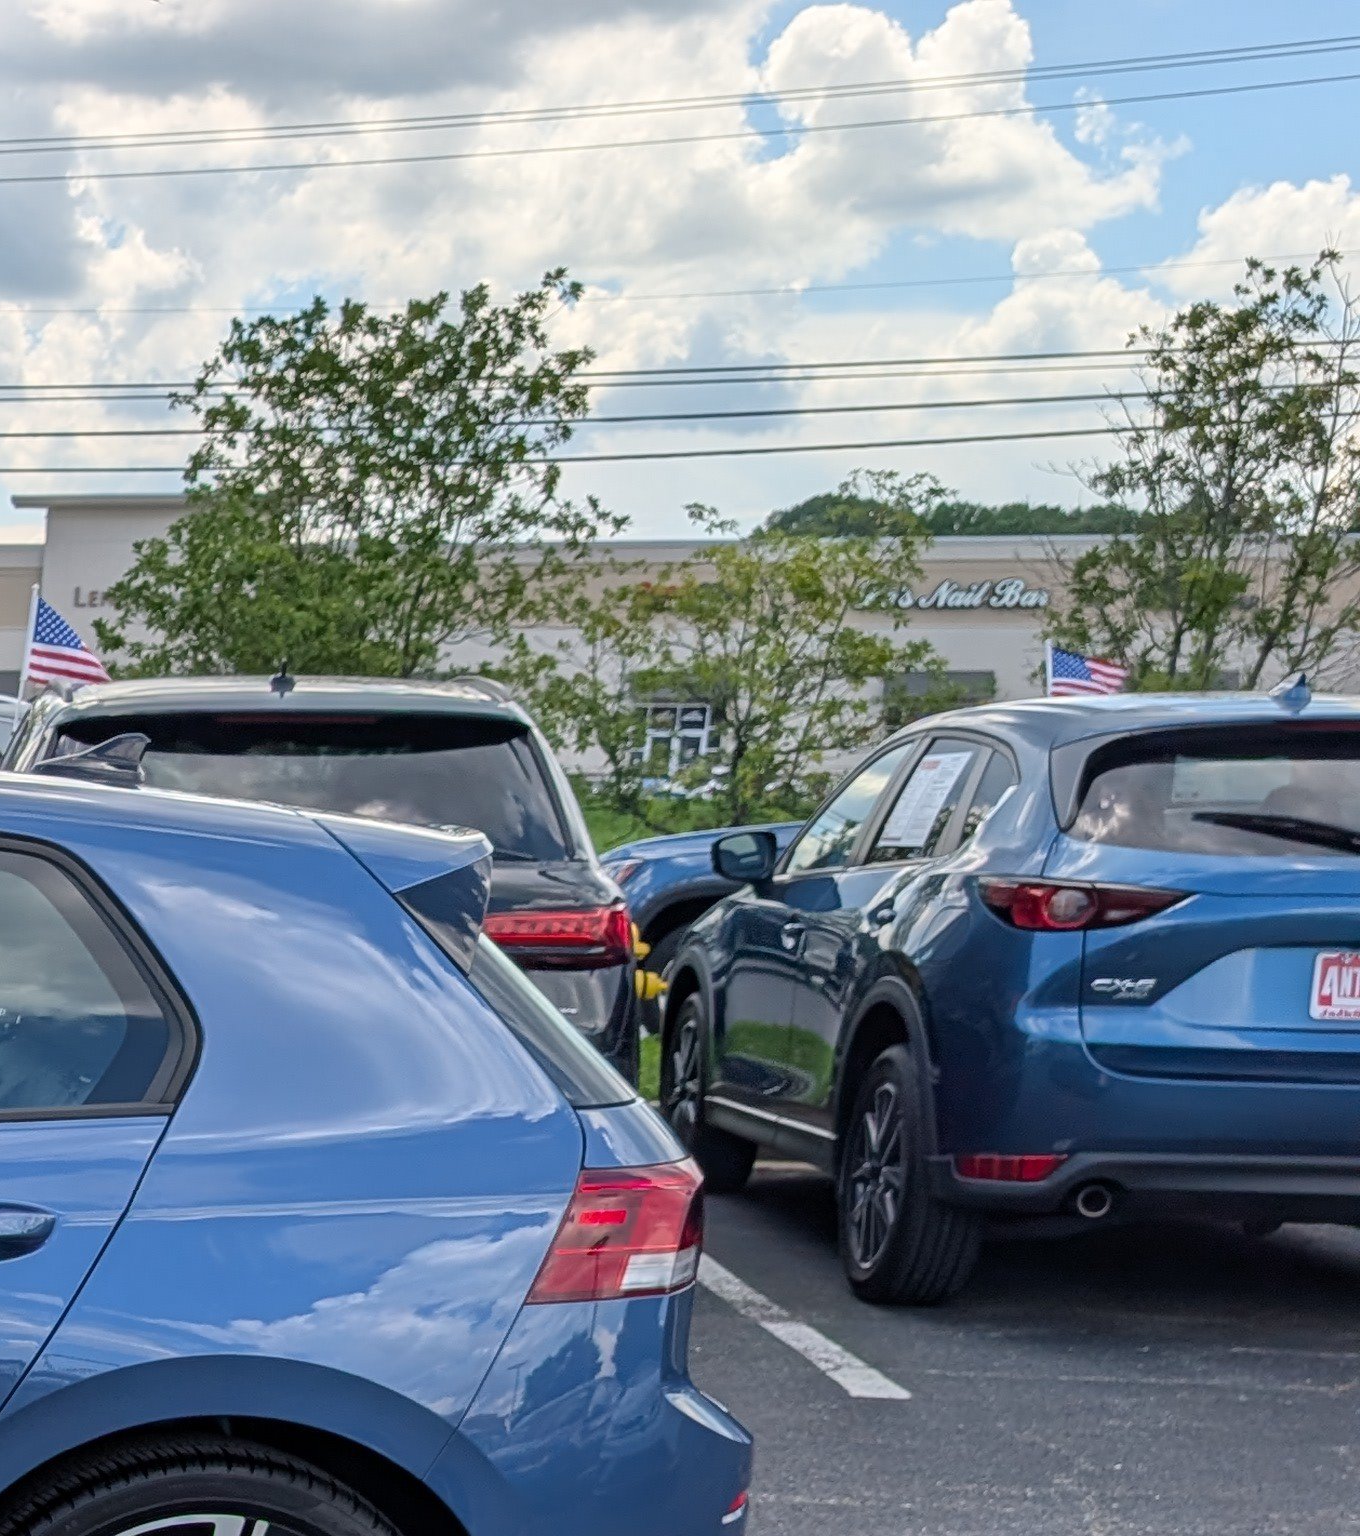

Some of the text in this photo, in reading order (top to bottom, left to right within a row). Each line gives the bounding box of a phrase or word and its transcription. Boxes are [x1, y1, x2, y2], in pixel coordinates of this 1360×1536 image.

[918, 577, 991, 609] Nail
[989, 577, 1050, 609] Bar
[1091, 978, 1157, 992] CX-5
